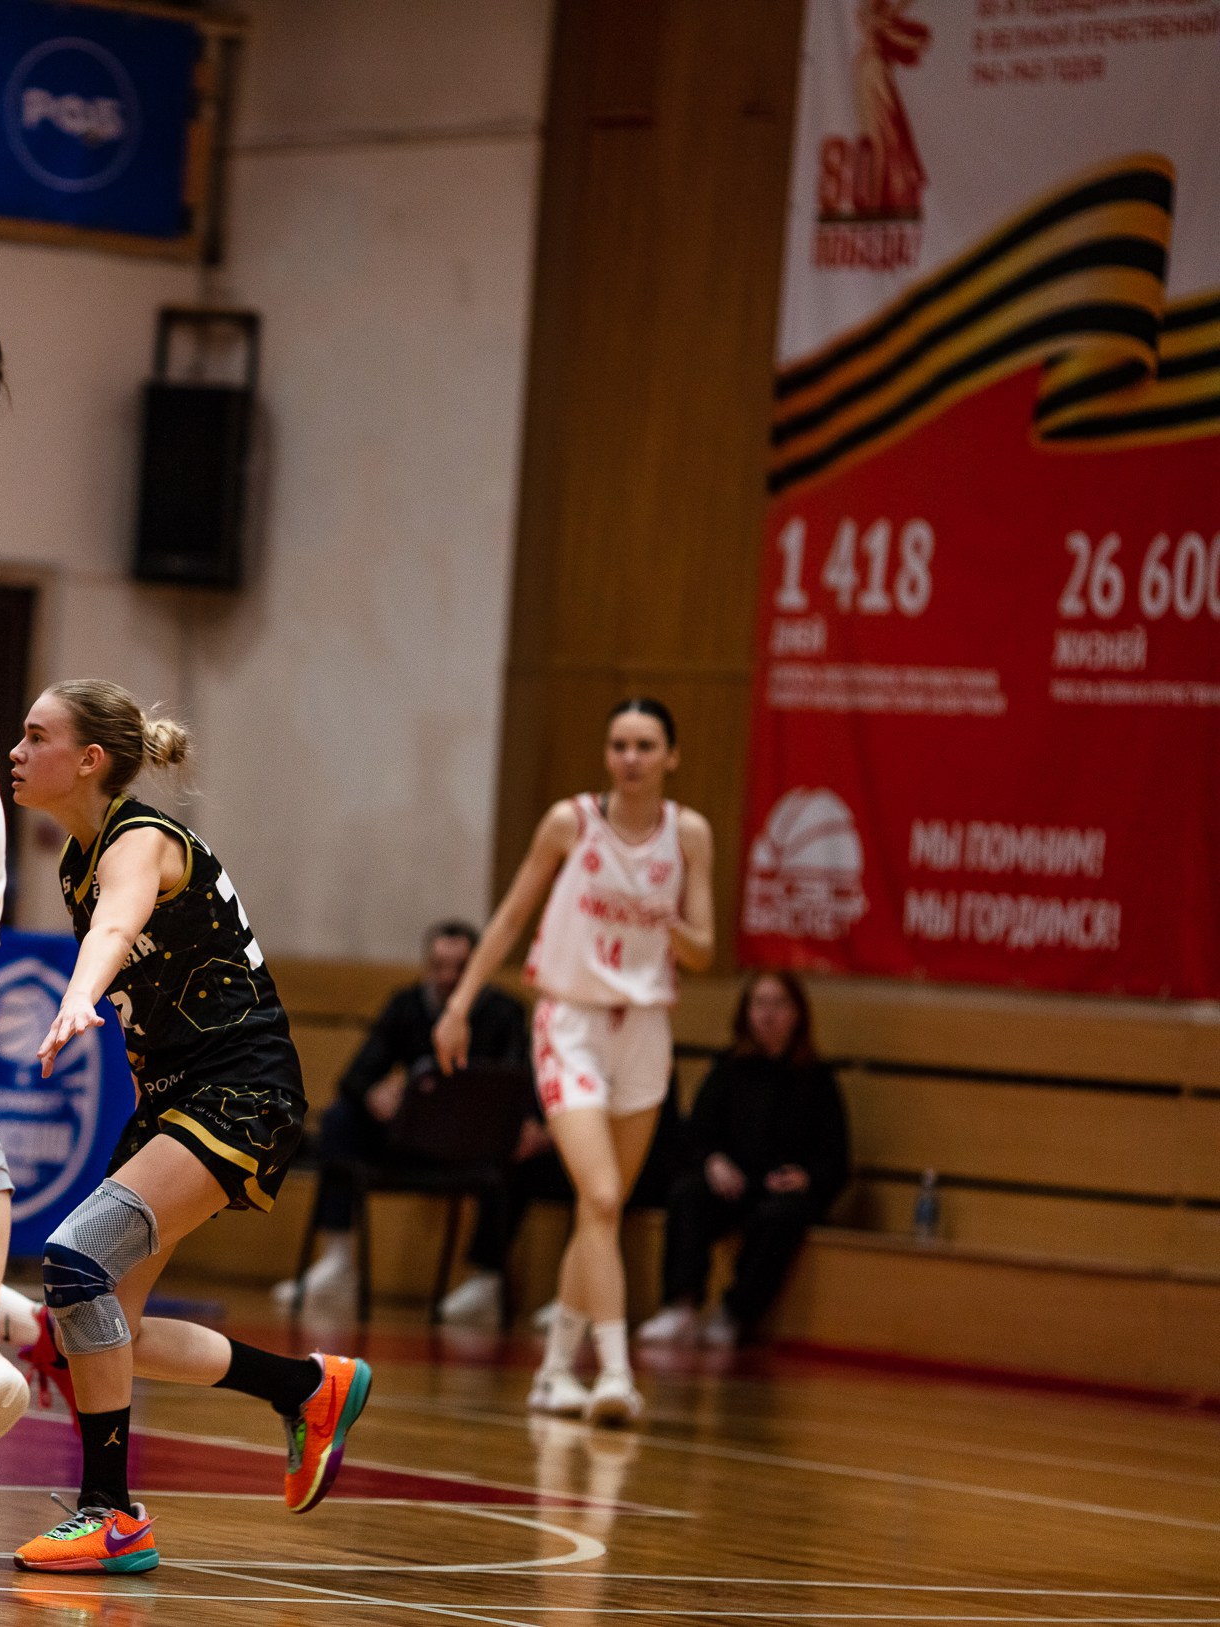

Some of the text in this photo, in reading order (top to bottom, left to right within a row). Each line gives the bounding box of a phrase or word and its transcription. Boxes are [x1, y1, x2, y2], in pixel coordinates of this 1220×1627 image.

[775, 516, 936, 618] 1 418
[1057, 529, 1125, 620] 26
